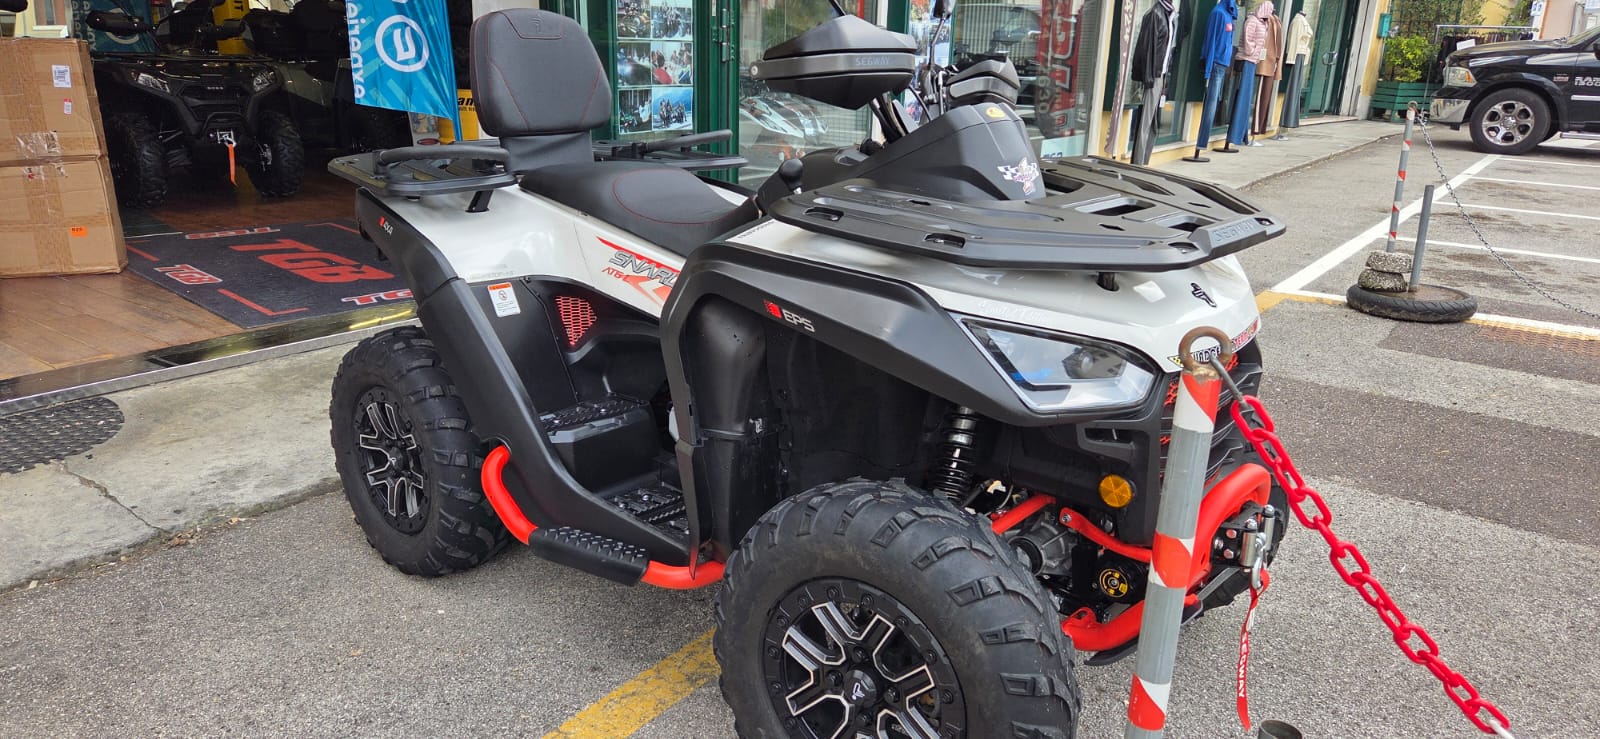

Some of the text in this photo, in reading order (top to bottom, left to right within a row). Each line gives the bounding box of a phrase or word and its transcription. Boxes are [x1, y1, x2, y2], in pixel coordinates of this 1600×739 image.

[855, 56, 889, 65] SEGWAY
[229, 239, 396, 283] TGB
[153, 263, 223, 285] TGB
[781, 308, 816, 333] EPS
[1238, 632, 1248, 698] SEGWAY
